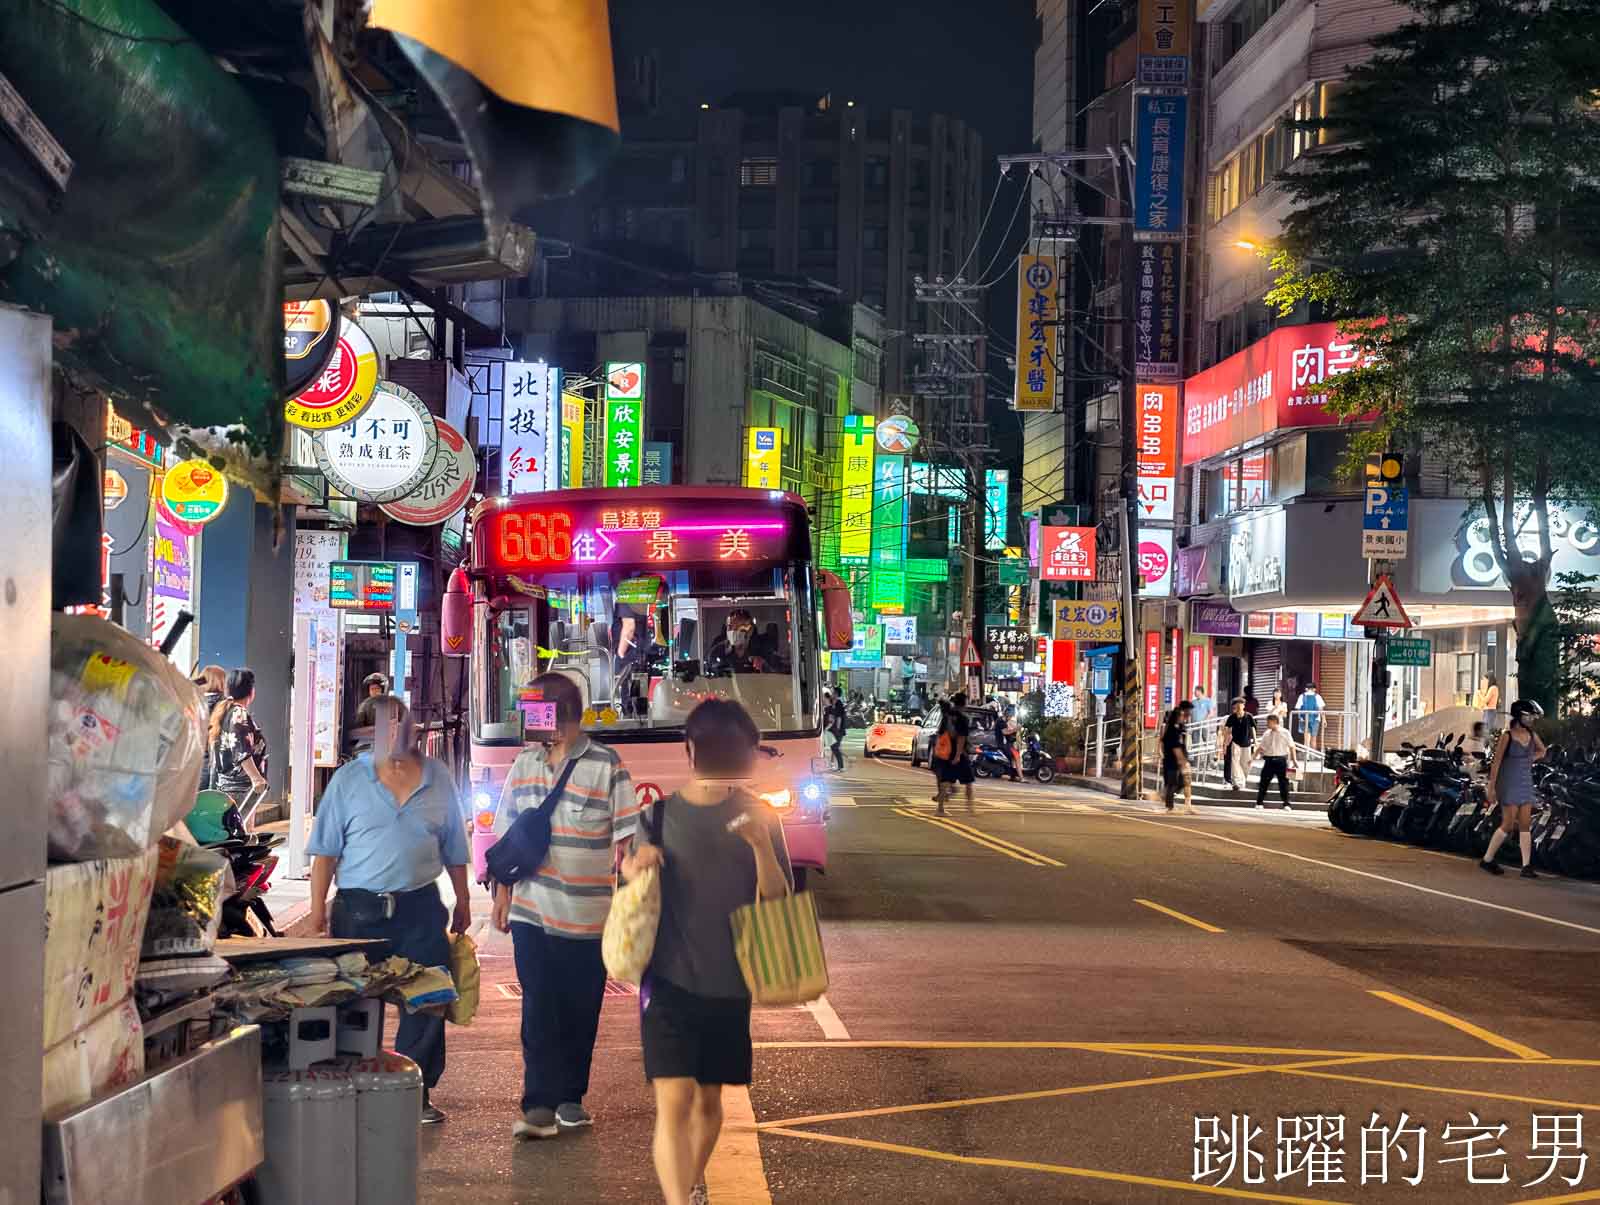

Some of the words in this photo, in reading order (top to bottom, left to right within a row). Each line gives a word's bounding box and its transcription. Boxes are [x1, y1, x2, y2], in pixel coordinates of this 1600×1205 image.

[336, 392, 363, 418] 更精彩
[1143, 392, 1164, 456] 肉多多
[339, 442, 412, 463] 熟成紅茶
[499, 513, 571, 562] 666
[572, 533, 597, 562] 往
[1366, 535, 1404, 545] 景美國小
[1059, 606, 1085, 623] 建宏
[989, 630, 1029, 644] 至善醫坊
